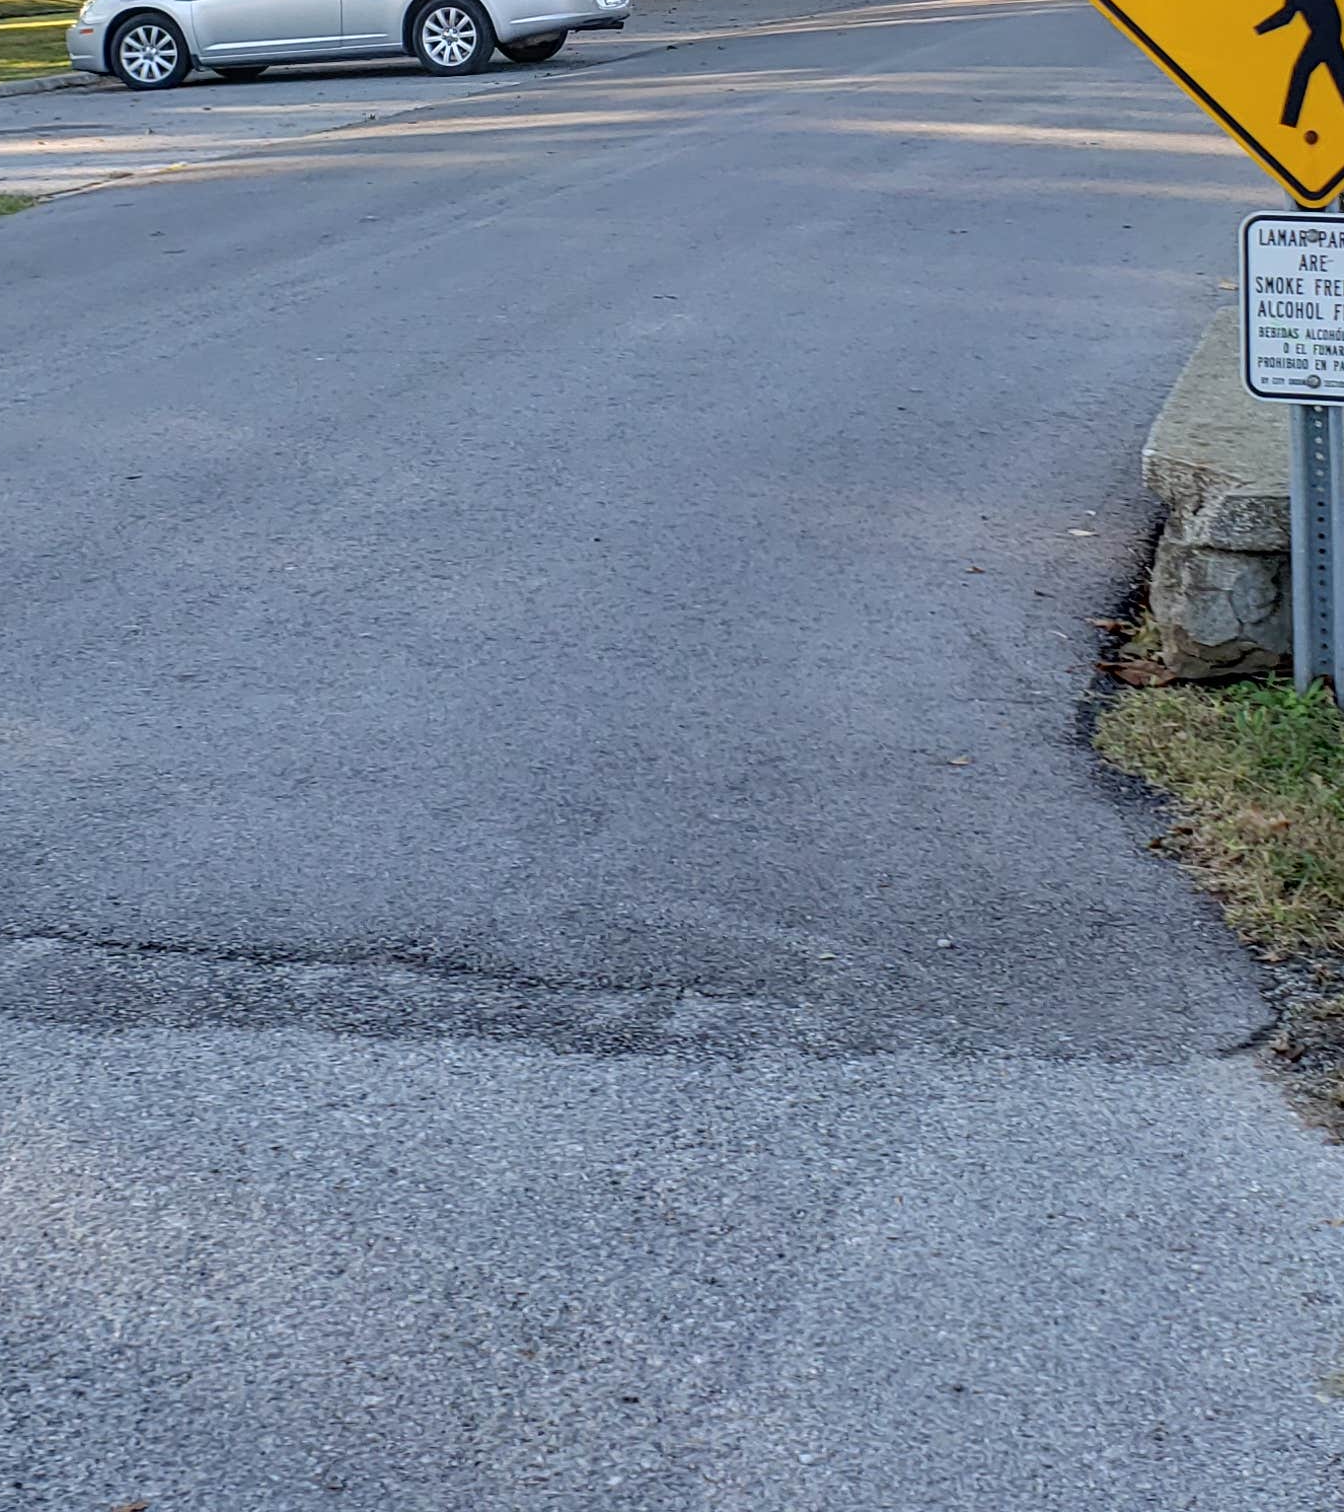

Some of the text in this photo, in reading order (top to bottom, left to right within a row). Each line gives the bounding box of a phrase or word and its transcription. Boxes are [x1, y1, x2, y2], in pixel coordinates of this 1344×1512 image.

[1259, 229, 1307, 247] LAMAR
[1298, 254, 1329, 272] ARE
[1256, 276, 1304, 295] SMOKE
[1257, 300, 1323, 320] ALCOHOL
[1258, 327, 1300, 339] BEBIDAS
[1296, 343, 1307, 355] EL
[1313, 344, 1344, 357] FUMAR
[1257, 357, 1309, 370] PROHIBIDO
[1315, 359, 1327, 371] EN
